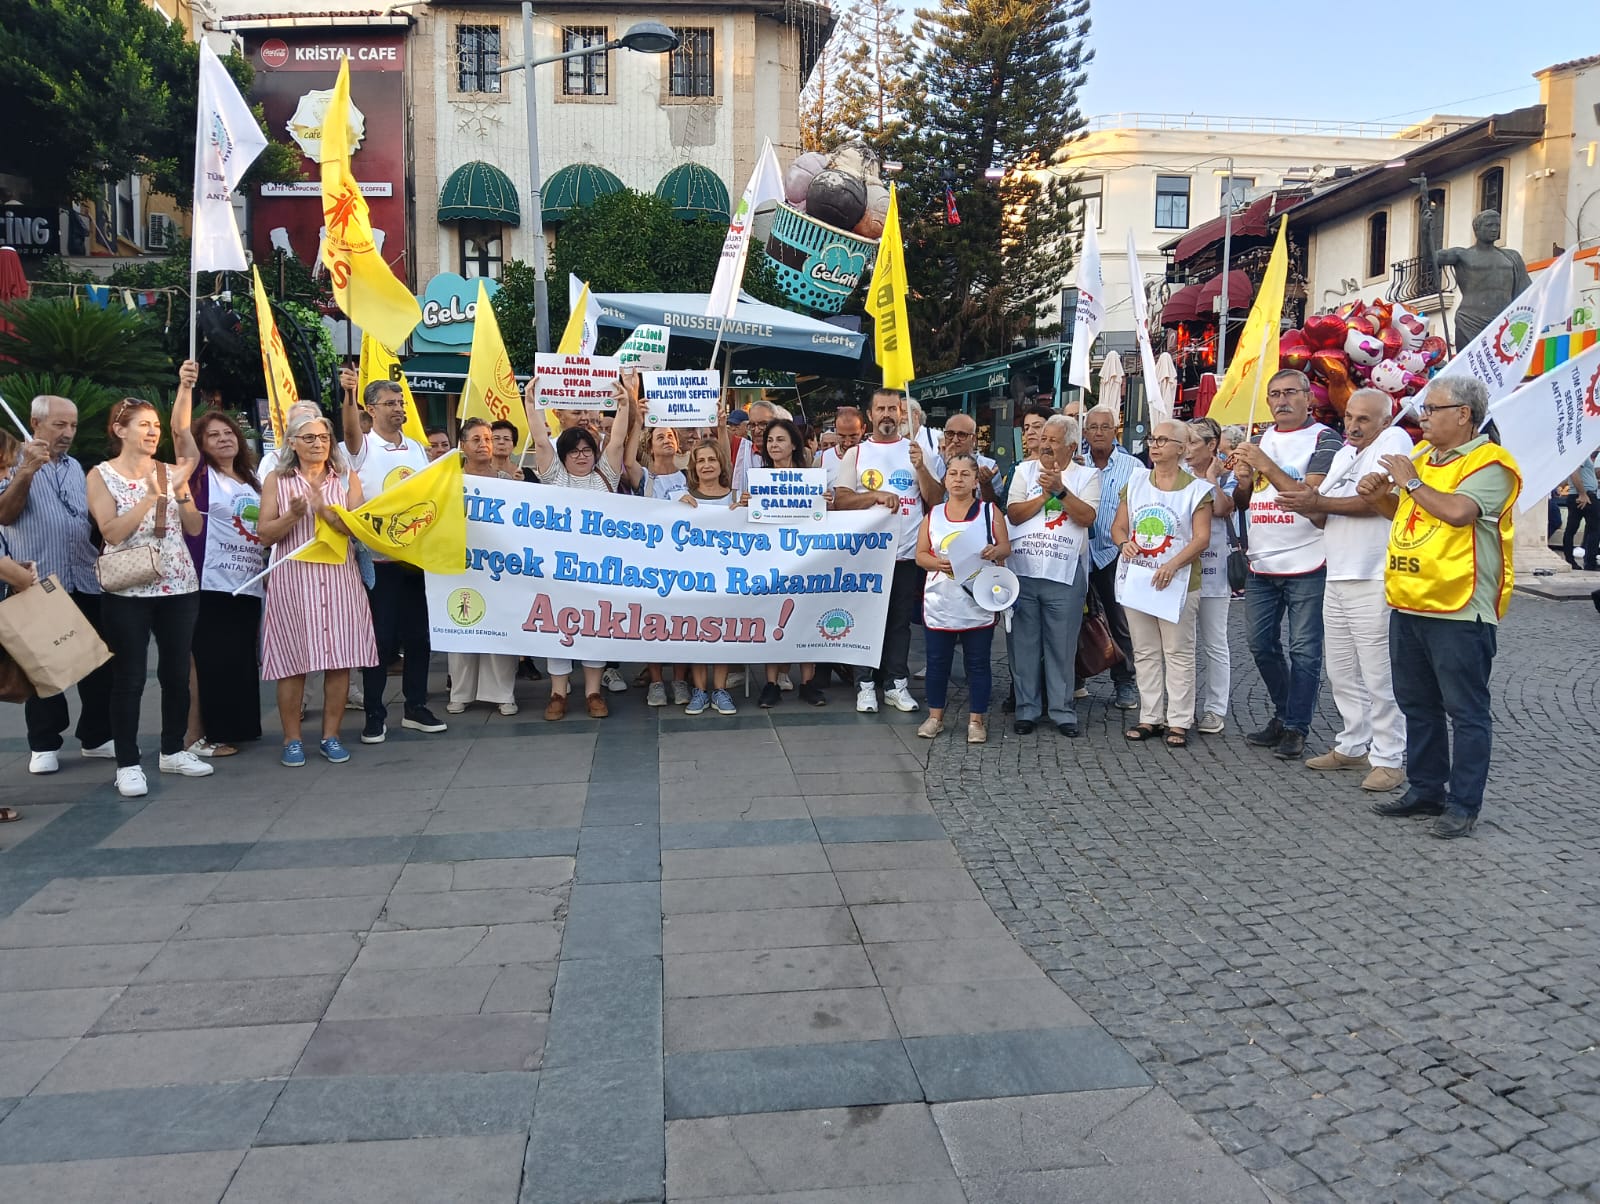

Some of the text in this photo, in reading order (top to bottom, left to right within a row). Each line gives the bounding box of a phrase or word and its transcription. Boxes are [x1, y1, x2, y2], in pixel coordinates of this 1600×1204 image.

[295, 45, 397, 60] KRİSTAL CAFE
[0, 211, 50, 244] İNG
[423, 295, 478, 326] GeLa
[723, 321, 773, 337] WAFFLE
[565, 356, 590, 365] ALMA
[620, 353, 641, 364] ÇEK
[537, 366, 617, 378] MAZLUMUN AHINI
[1571, 365, 1581, 388] TÜM
[563, 378, 591, 388] ÇIKAR
[657, 375, 708, 388] HAYDİ AÇIKLA!
[541, 389, 613, 398] AHESTE AHESTE
[646, 390, 687, 399] ENFLASYON
[485, 387, 511, 421] BES
[1551, 380, 1565, 424] ANTALYA
[667, 403, 701, 415] AÇIKLA...
[1564, 389, 1574, 437] SENDİKASI
[770, 470, 803, 482] TÜİK
[750, 485, 824, 496] EMEĞİMİZİ
[761, 498, 812, 510] ÇALMA!
[464, 486, 893, 557] İK deki Hesap Çarşıya Uymuyor
[219, 543, 237, 552] TÜM
[1021, 541, 1059, 550] SENDİKASI
[1014, 548, 1044, 556] ANTALYA
[1390, 555, 1420, 573] BES
[464, 547, 883, 597] erçek Enflasyon Rakamları
[475, 629, 508, 637] SENDİKASI
